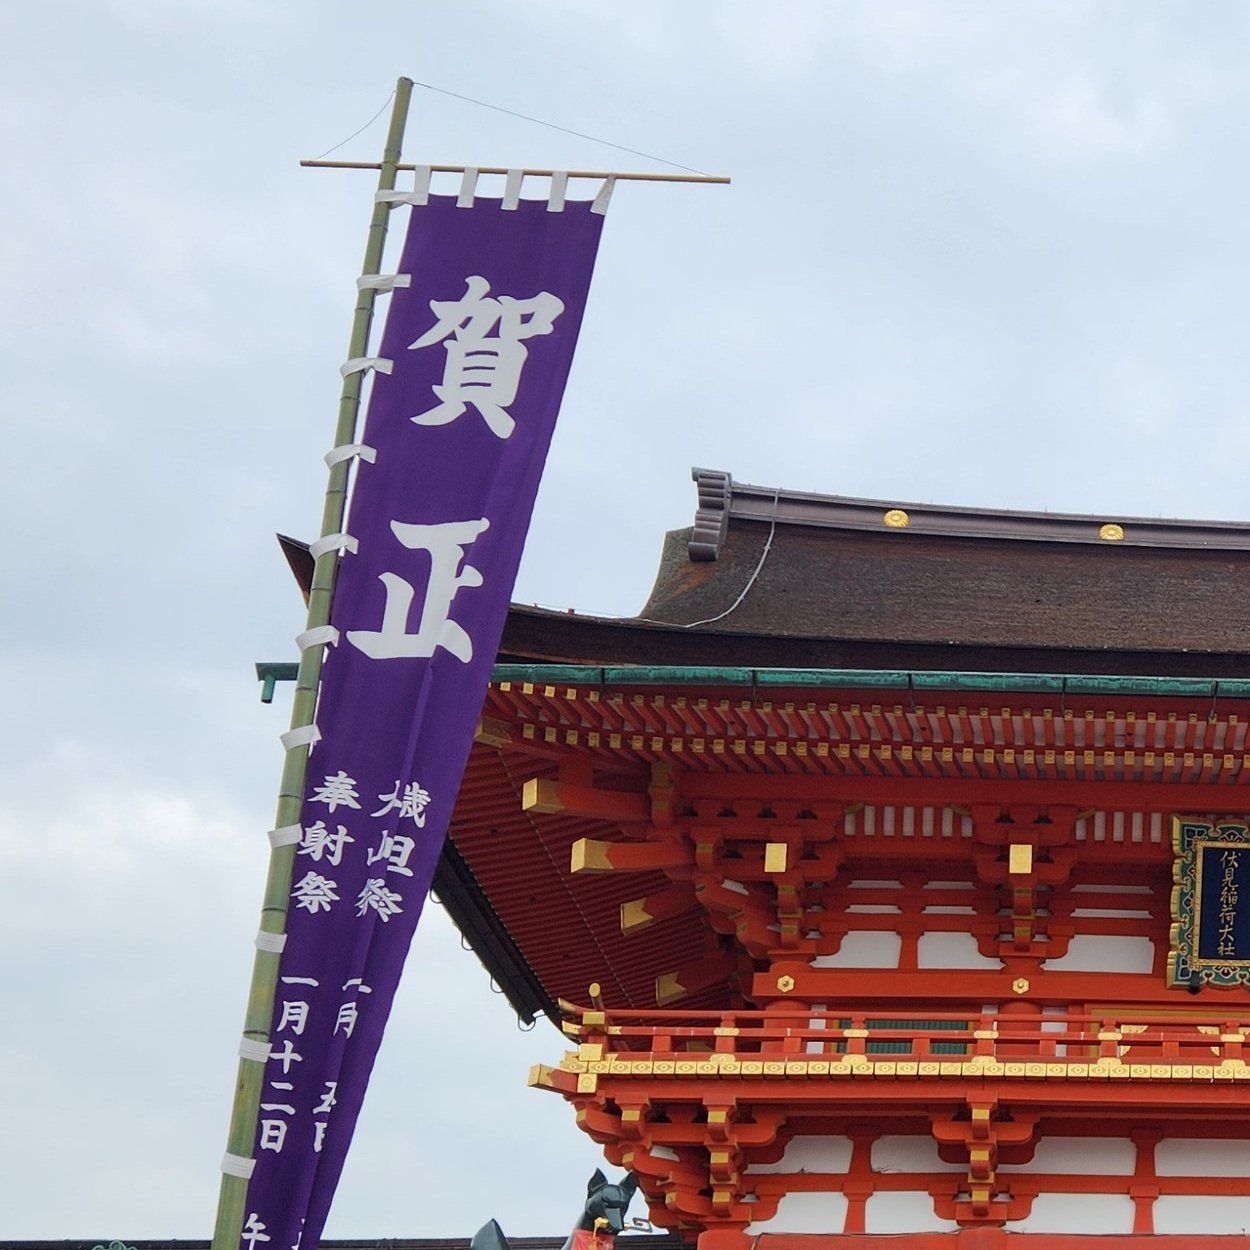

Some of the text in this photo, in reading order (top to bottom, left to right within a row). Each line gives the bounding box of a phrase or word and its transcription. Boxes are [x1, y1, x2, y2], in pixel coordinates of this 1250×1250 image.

[347, 275, 565, 664] 賀正
[290, 771, 362, 914] 奉射祭
[1217, 850, 1242, 957] 伏見稲荷大社
[260, 976, 319, 1154] 一月十二日
